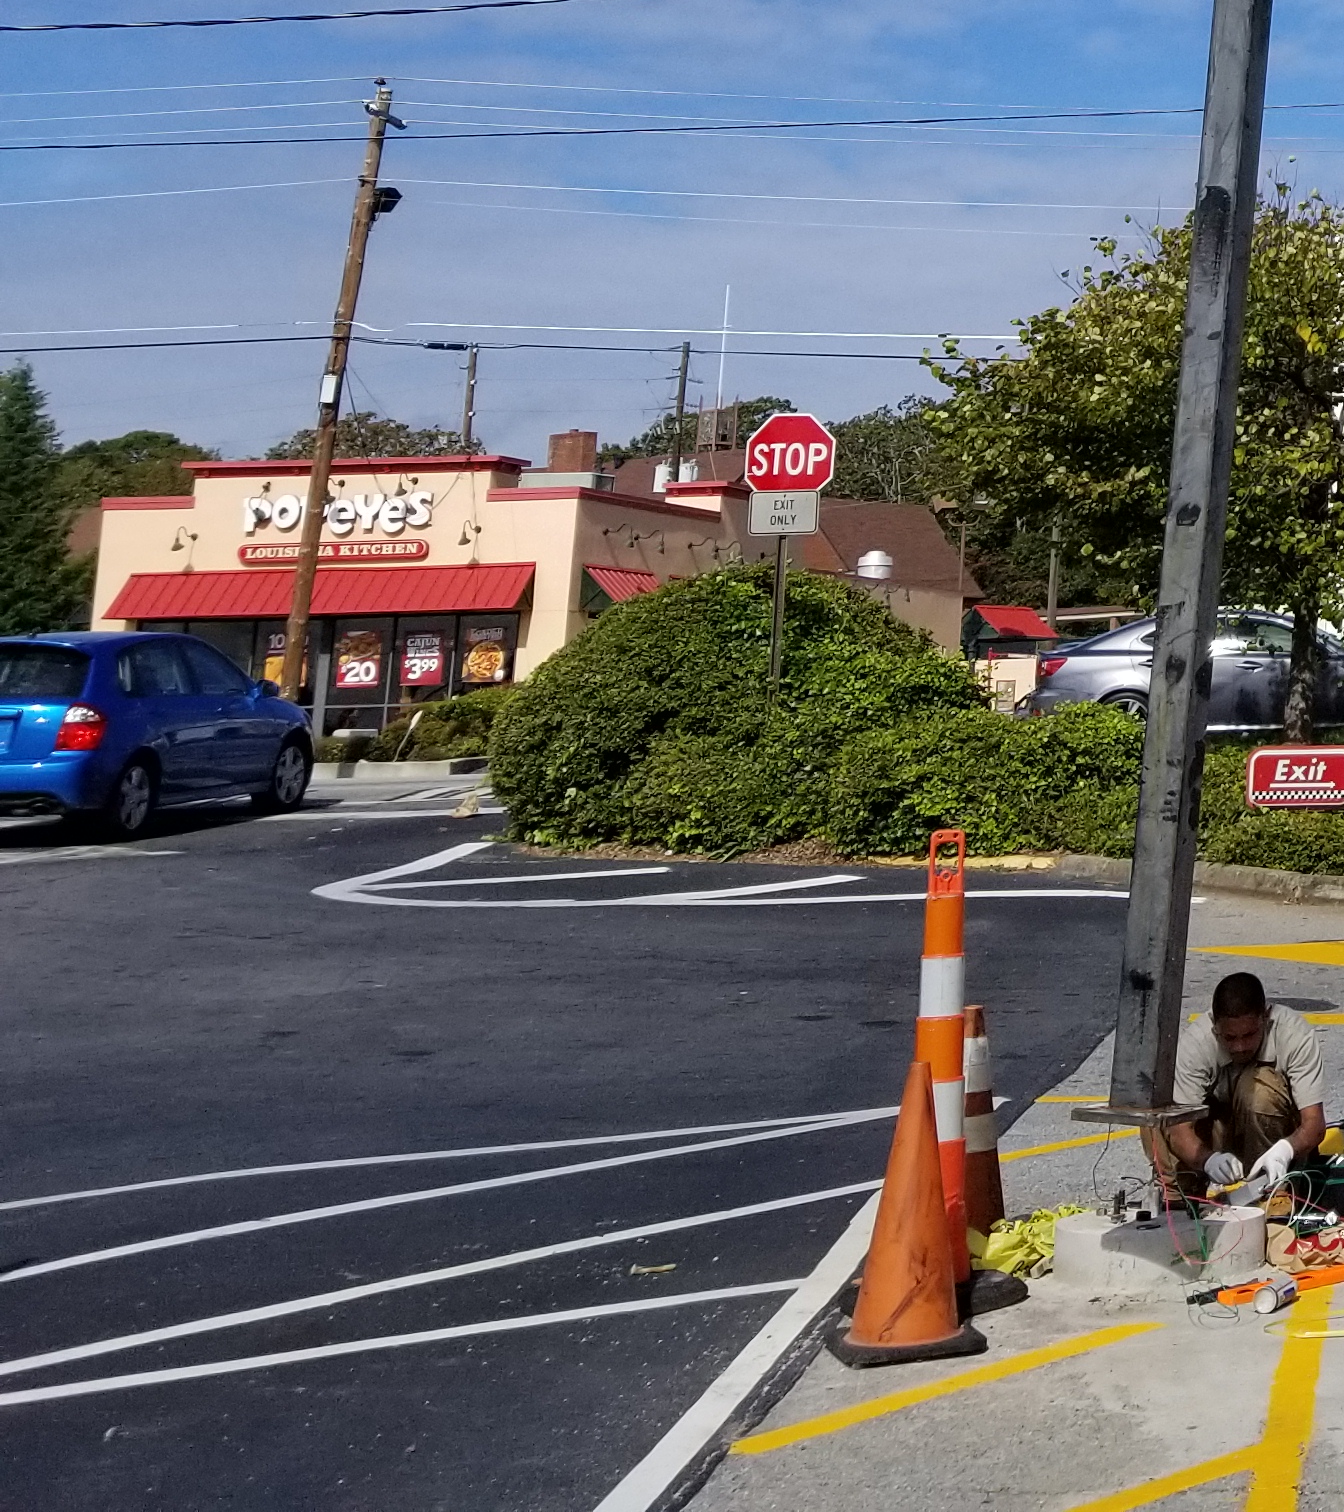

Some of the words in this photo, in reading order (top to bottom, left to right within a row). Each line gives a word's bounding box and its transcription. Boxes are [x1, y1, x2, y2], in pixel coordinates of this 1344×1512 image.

[751, 442, 828, 477] STOP
[773, 499, 795, 511] EXIT
[769, 514, 797, 526] ONLY
[338, 542, 419, 557] KITCHEN
[406, 637, 441, 648] CAJUN
[340, 661, 376, 682] $20
[1274, 757, 1327, 781] Exit
